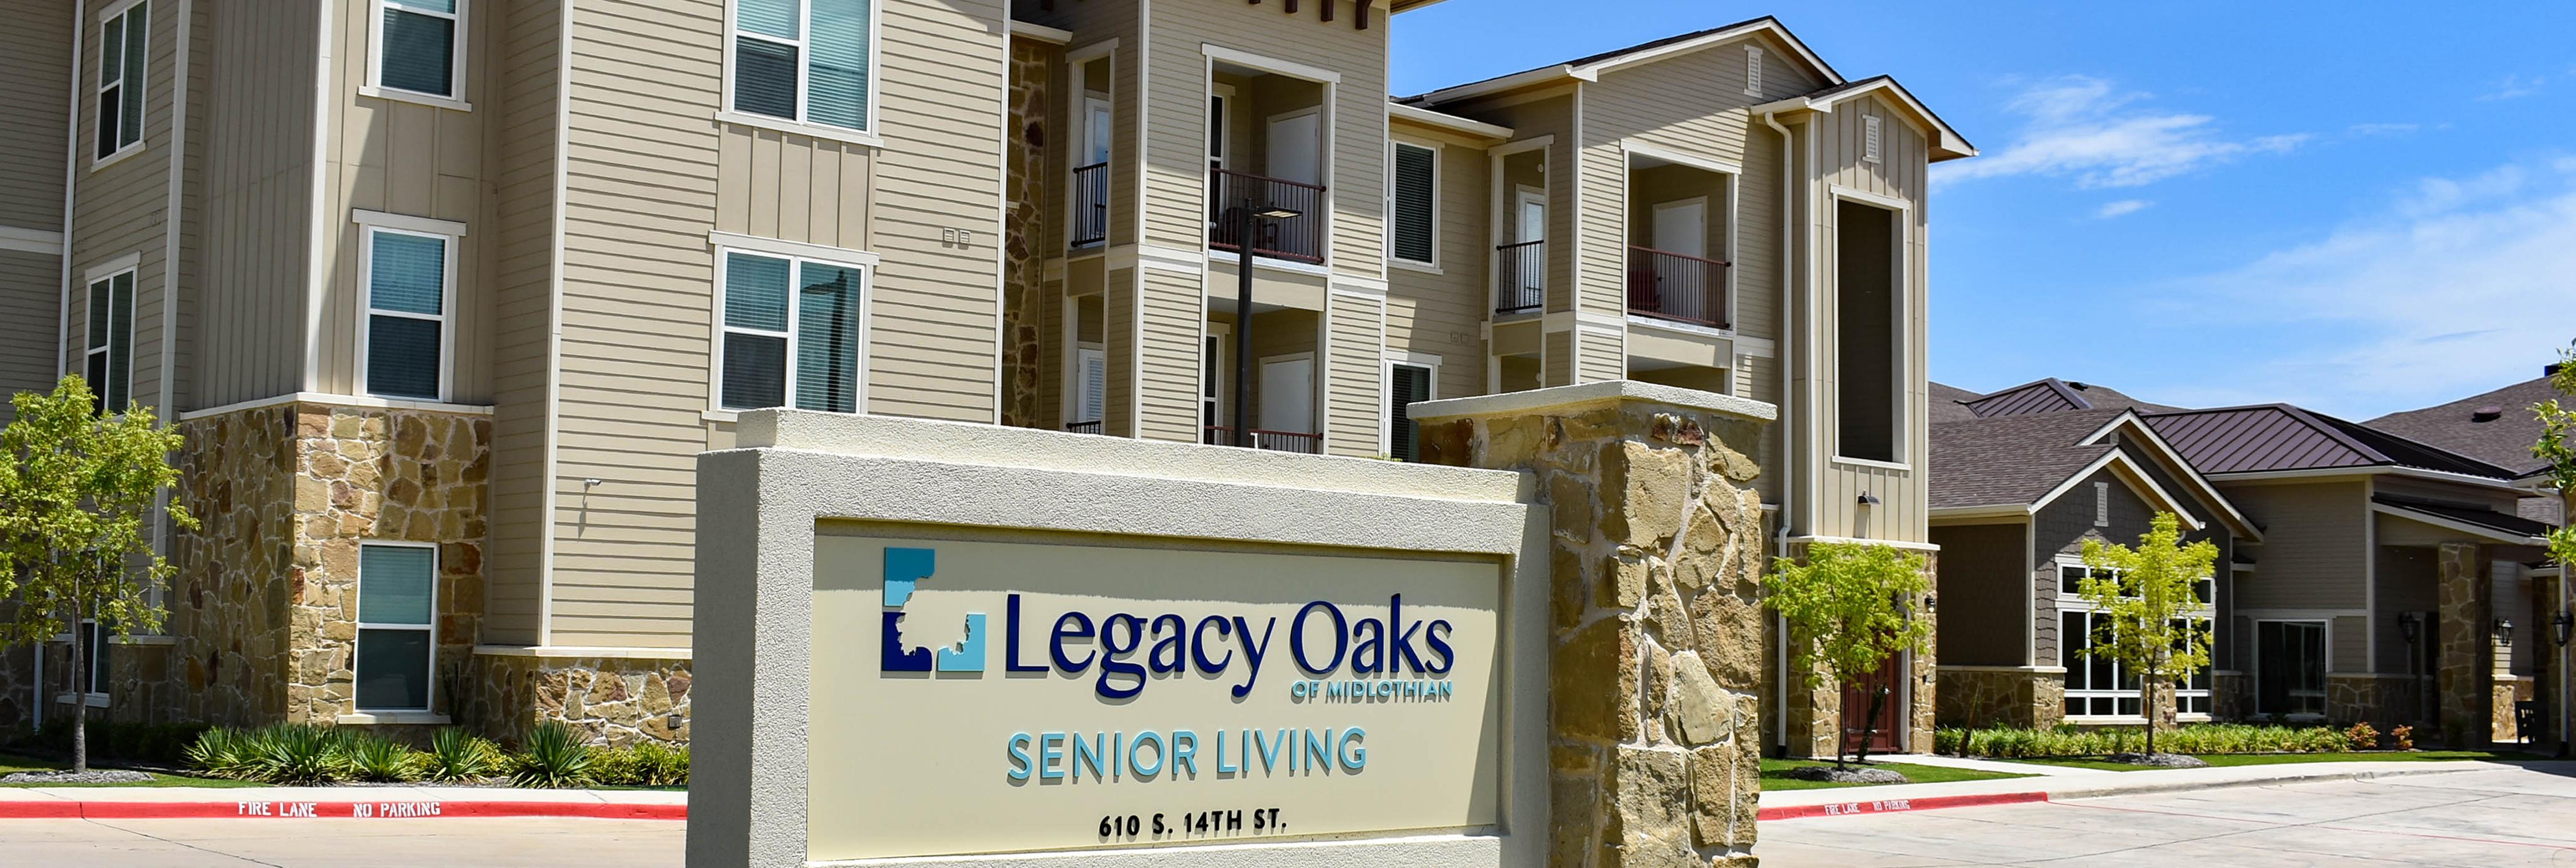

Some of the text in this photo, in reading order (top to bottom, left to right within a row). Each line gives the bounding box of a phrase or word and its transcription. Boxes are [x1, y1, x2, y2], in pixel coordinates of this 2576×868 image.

[1005, 592, 1455, 699] Legacy Oaks
[1291, 680, 1453, 698] OF MIDLOTHIAN
[1008, 727, 1367, 779] SENIOR LIVING
[238, 801, 440, 817] FIRE LANE NO PARKING
[1825, 799, 1910, 815] FIRE LANE NO PARKING
[1099, 808, 1287, 837] 610 S. 14TH ST.
